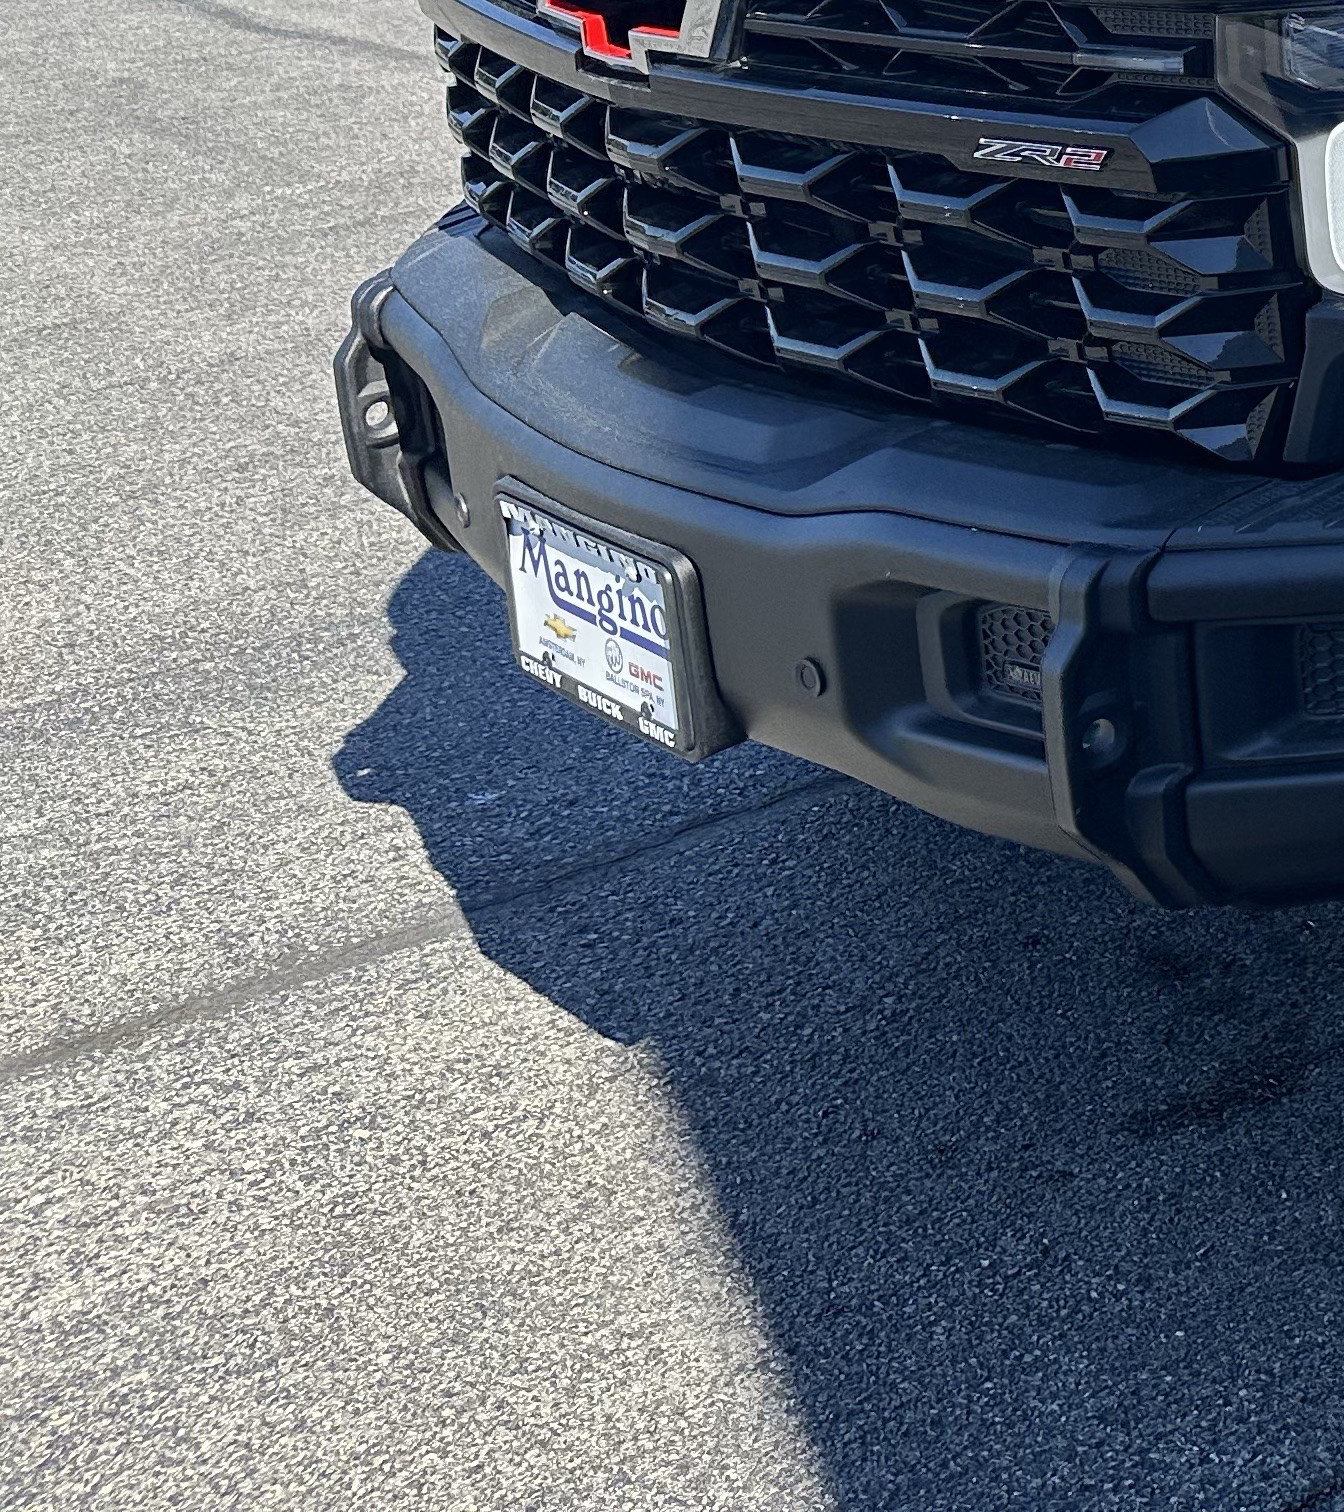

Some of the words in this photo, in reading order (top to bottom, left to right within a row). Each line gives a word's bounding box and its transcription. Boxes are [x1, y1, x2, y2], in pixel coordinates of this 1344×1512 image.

[973, 137, 1110, 172] ZR2
[519, 526, 668, 639] Mangino
[520, 655, 563, 688] CHEVY
[628, 661, 665, 692] GMC
[577, 685, 623, 721] BUICK
[638, 716, 675, 748] GMC
